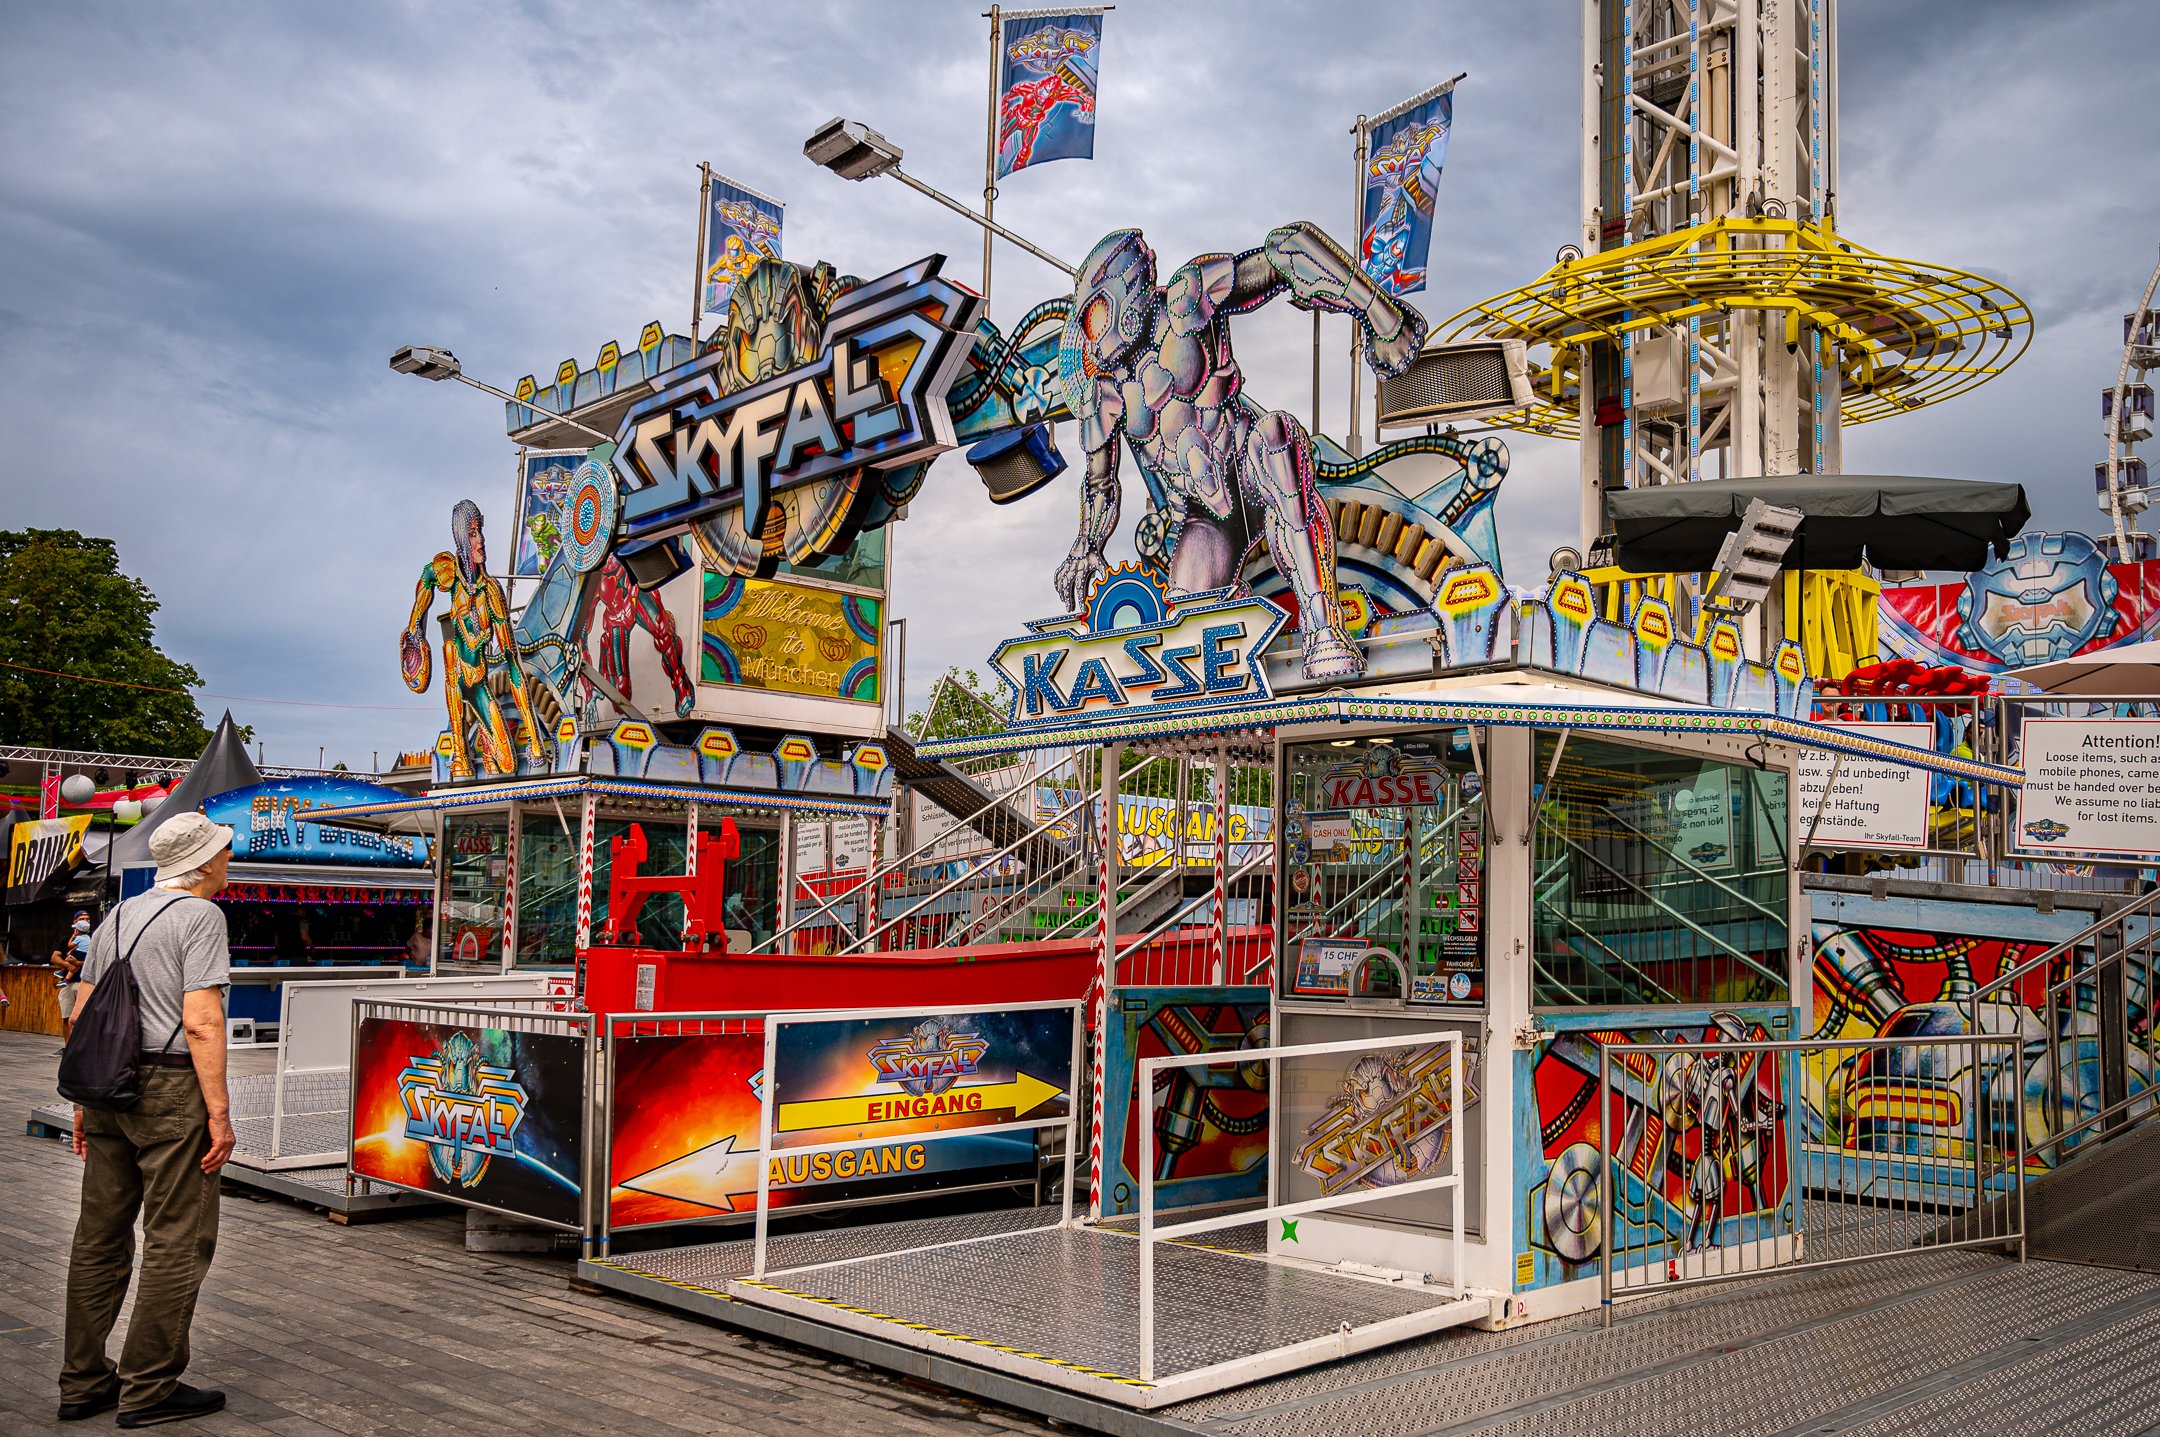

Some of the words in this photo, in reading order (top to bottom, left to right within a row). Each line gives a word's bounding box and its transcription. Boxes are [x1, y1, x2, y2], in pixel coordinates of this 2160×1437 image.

[623, 336, 904, 540] SKYFALL
[745, 588, 845, 631] Welcome
[780, 630, 806, 655] to
[743, 656, 841, 688] München
[1023, 622, 1251, 715] KASSE
[2082, 734, 2160, 748] Attention!
[2046, 752, 2078, 762] Loose
[2082, 752, 2116, 764] items,
[2120, 753, 2147, 764] such
[1799, 767, 1823, 777] usw.
[1827, 767, 1849, 778] snd
[1853, 768, 1910, 782] unbedingt
[2040, 768, 2076, 777] mobile
[2080, 768, 2124, 779] phones,
[1331, 775, 1435, 807] KASSE
[1800, 782, 1863, 795] abzueben!
[2026, 781, 2054, 791] must
[2057, 782, 2071, 791] be
[2074, 782, 2115, 793] handed
[2119, 785, 2144, 794] over
[1835, 799, 1880, 814] Haftung
[2055, 796, 2072, 806] We
[2075, 797, 2119, 808] assume
[2123, 799, 2137, 808] no
[2078, 811, 2094, 821] for
[2097, 811, 2118, 822] lost
[2121, 812, 2157, 823] items.
[1313, 829, 1332, 838] CASH
[1333, 828, 1350, 837] ONLY
[1876, 833, 1921, 843] Skyfall-Team
[458, 836, 491, 854] KASSE
[1324, 950, 1335, 960] 15
[1337, 951, 1359, 961] CHF
[880, 1048, 976, 1088] SKYFALL
[868, 1092, 982, 1121] EINGANG
[407, 1085, 516, 1167] SKYFALL
[768, 1144, 926, 1186] AUSGANG
